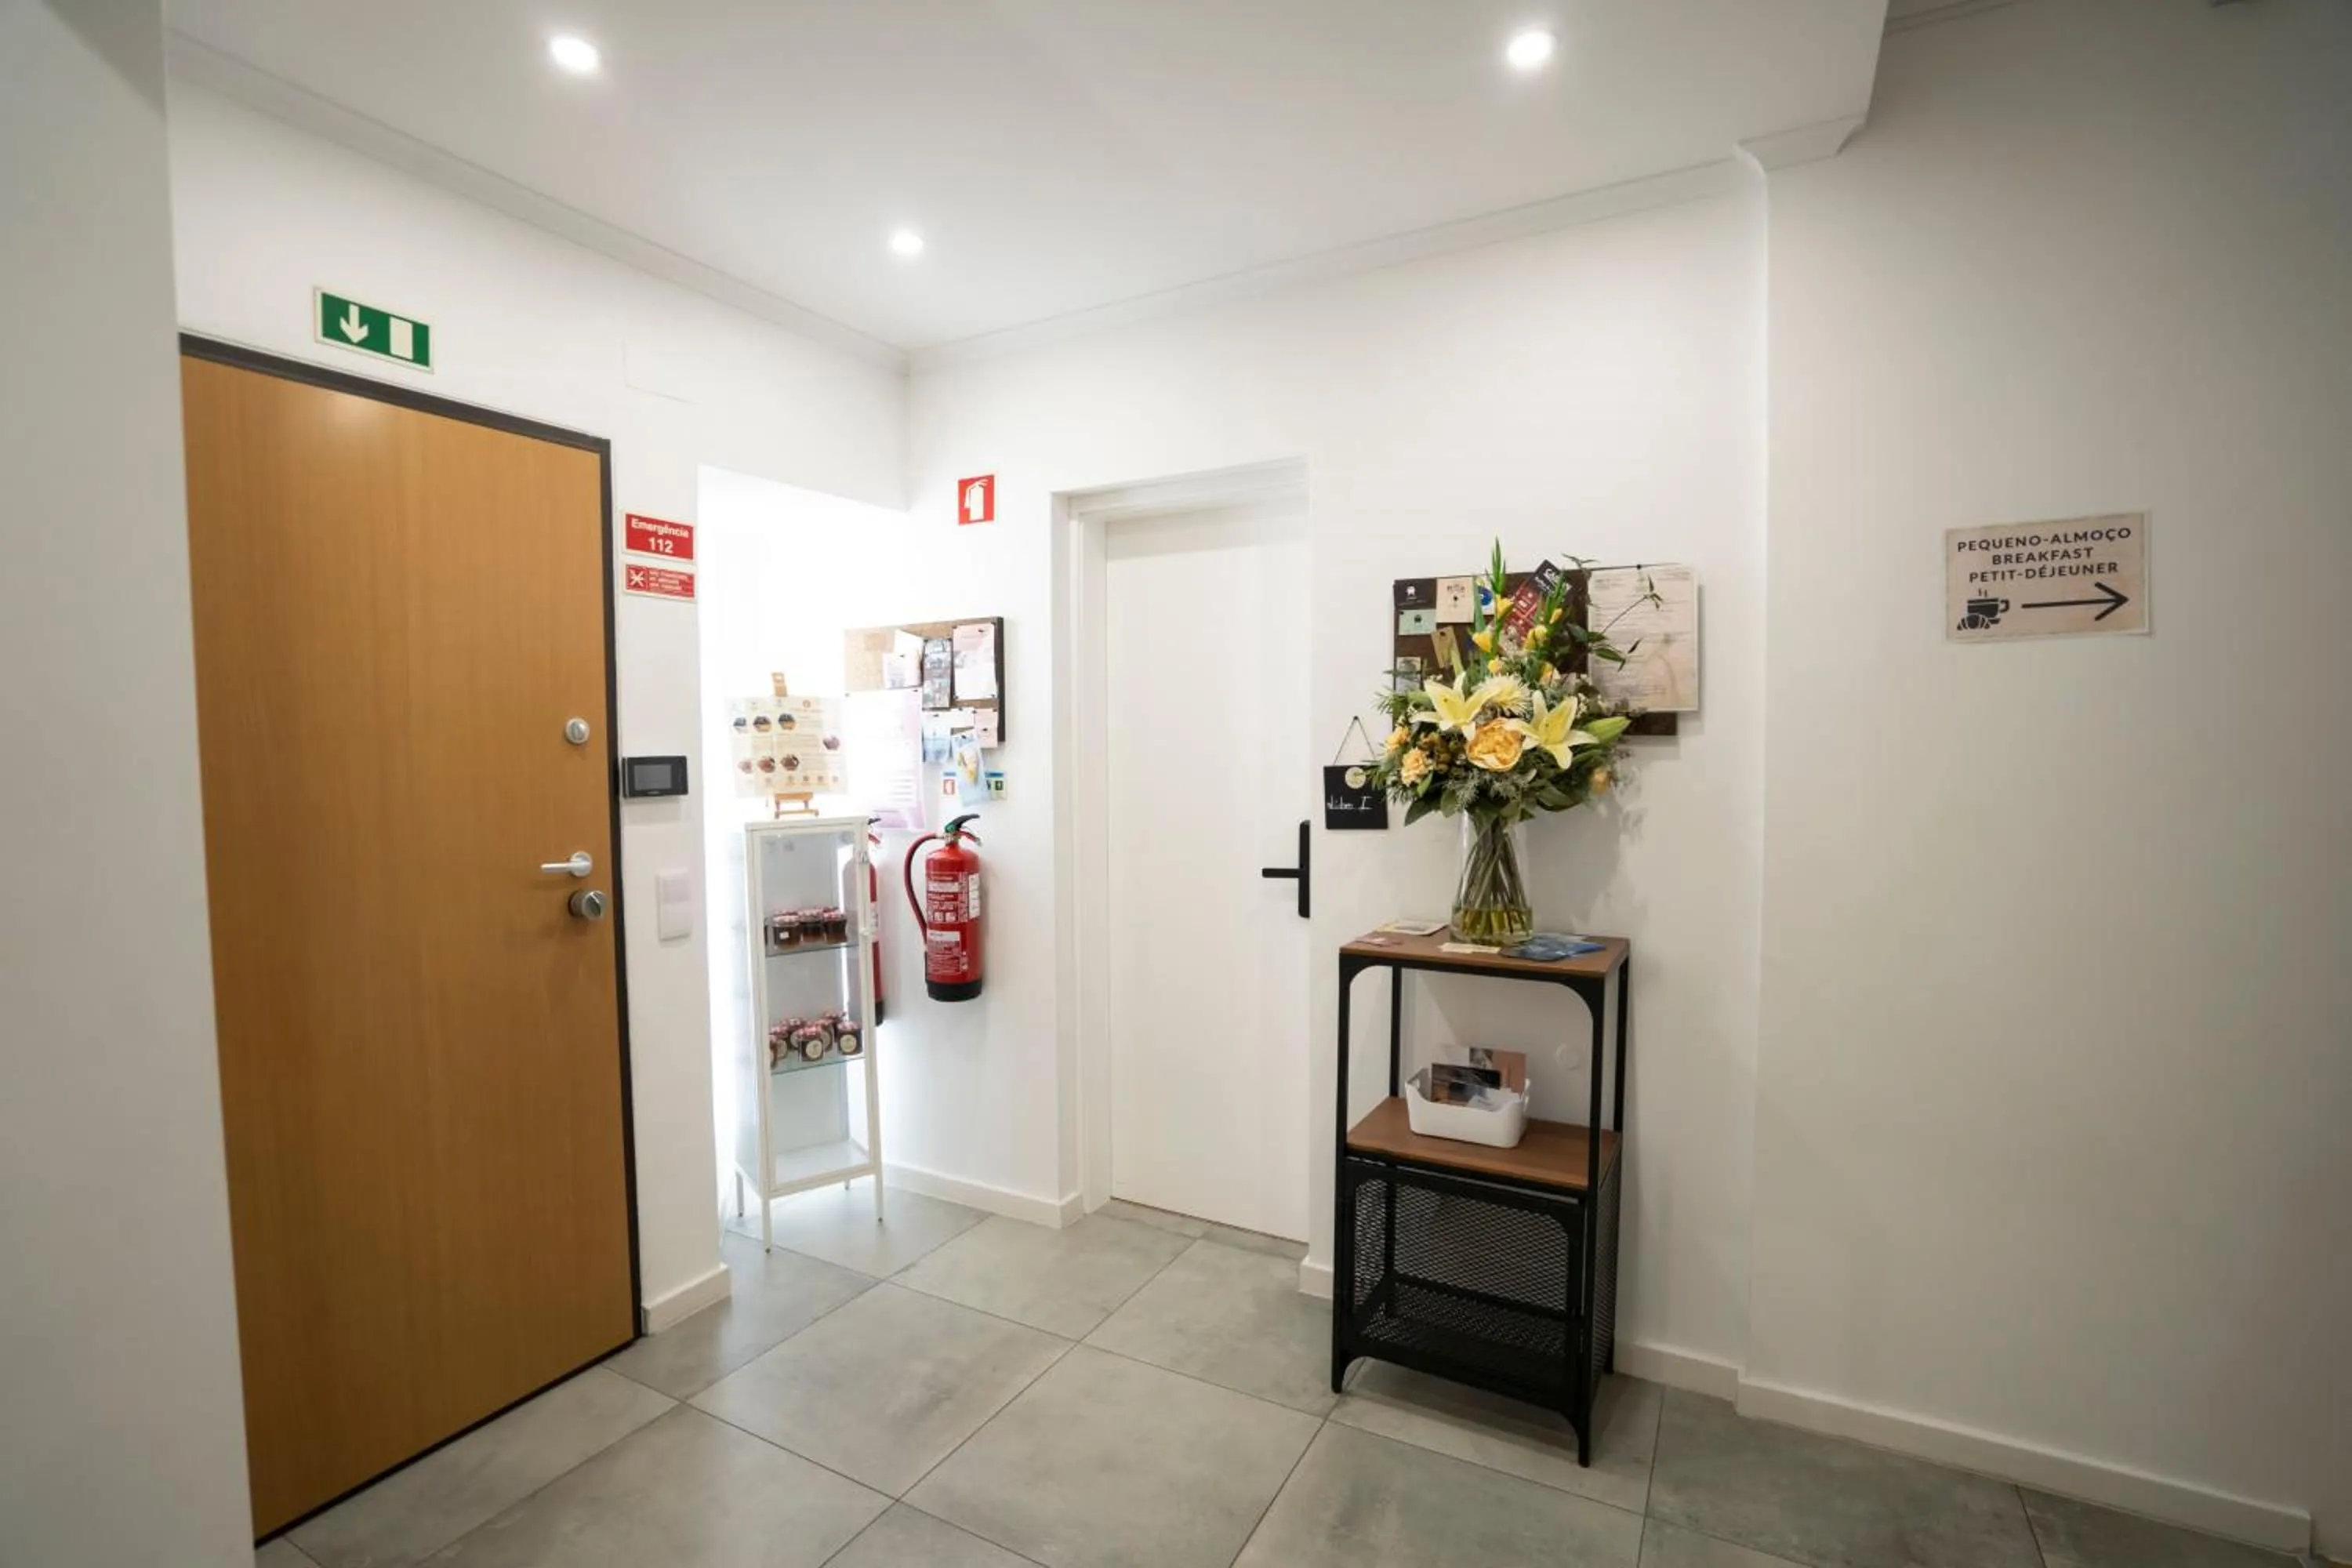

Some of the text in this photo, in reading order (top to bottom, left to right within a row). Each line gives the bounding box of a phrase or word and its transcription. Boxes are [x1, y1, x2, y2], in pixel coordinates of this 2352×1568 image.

[631, 518, 689, 538] Emergência
[648, 537, 674, 554] 112
[1957, 527, 2132, 552] PEQUENO-ALMOÇO
[1991, 546, 2094, 565] BREAKFAST
[1969, 561, 2118, 583] PETIT-DÉJEUNER
